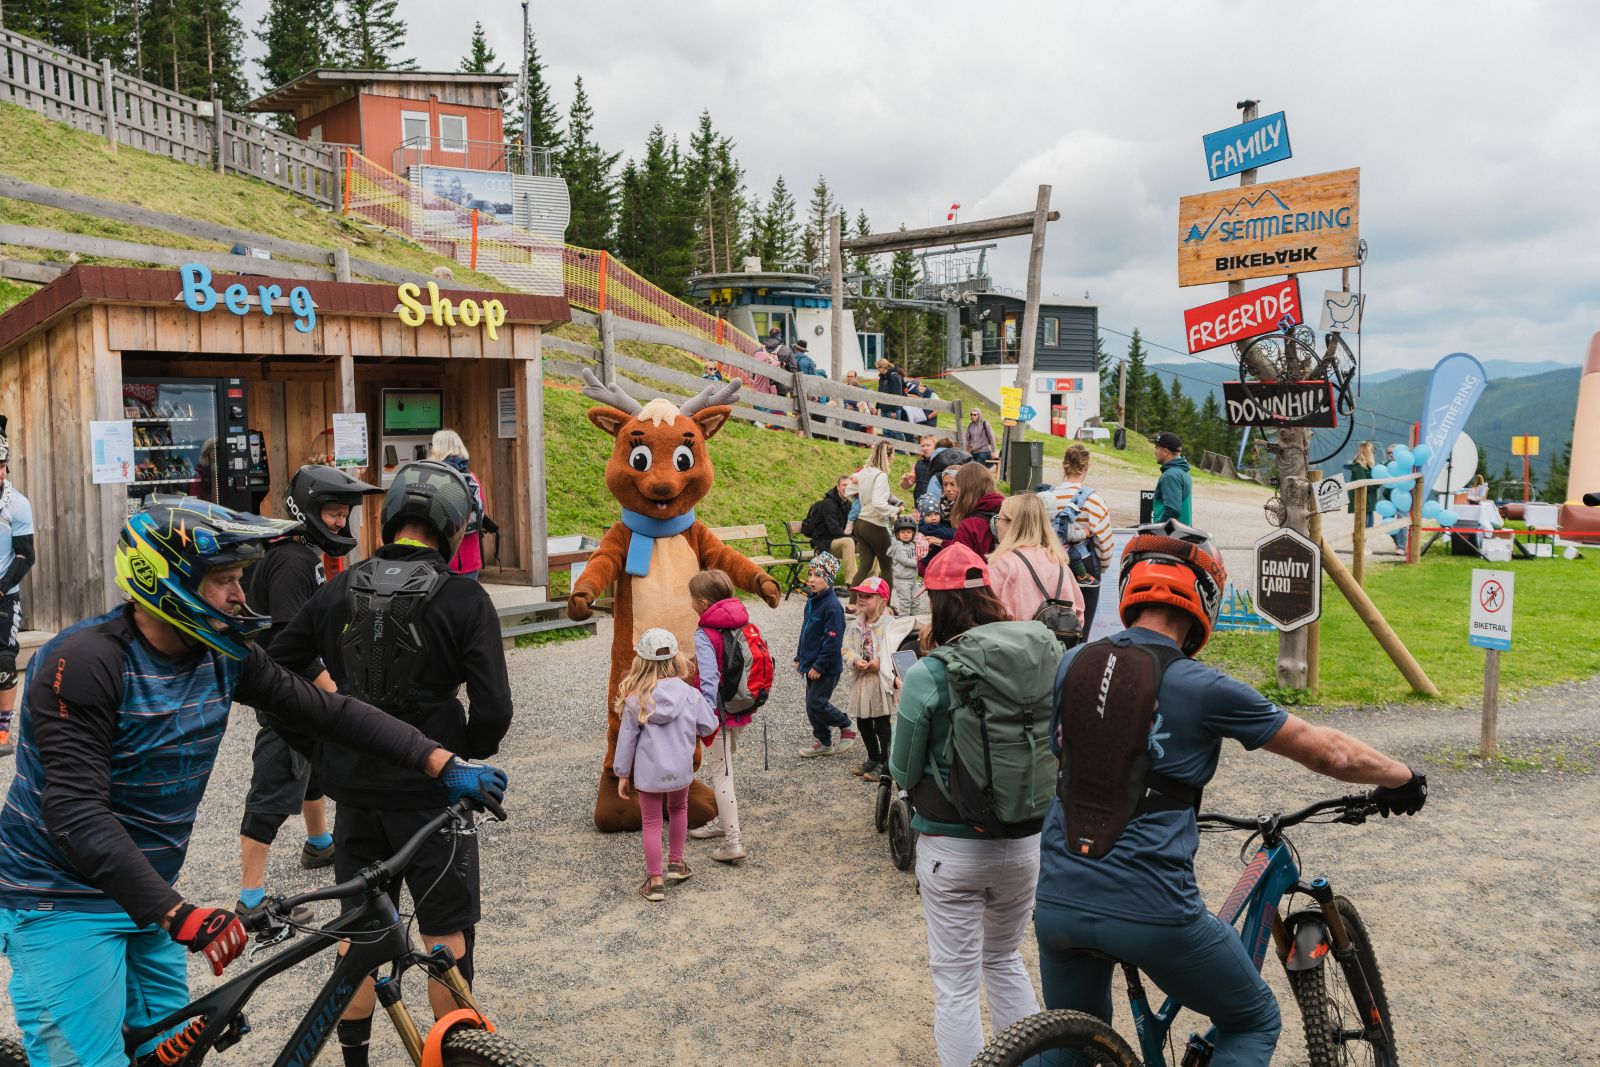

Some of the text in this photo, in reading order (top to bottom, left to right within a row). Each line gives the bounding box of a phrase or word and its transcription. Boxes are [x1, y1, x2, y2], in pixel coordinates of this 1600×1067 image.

[1210, 119, 1282, 177] FAMILY
[1219, 206, 1351, 243] SEMMERING
[179, 262, 505, 341] Berg Shop
[1188, 286, 1295, 352] FREERIDE
[1227, 388, 1330, 424] DOWNHILL
[1433, 374, 1478, 448] SEMMERING
[286, 496, 307, 522] POC
[1262, 557, 1310, 578] GRAVITY
[1262, 576, 1291, 597] CARD
[1473, 621, 1508, 633] BIKETRAIL
[1096, 652, 1118, 719] SCOTT
